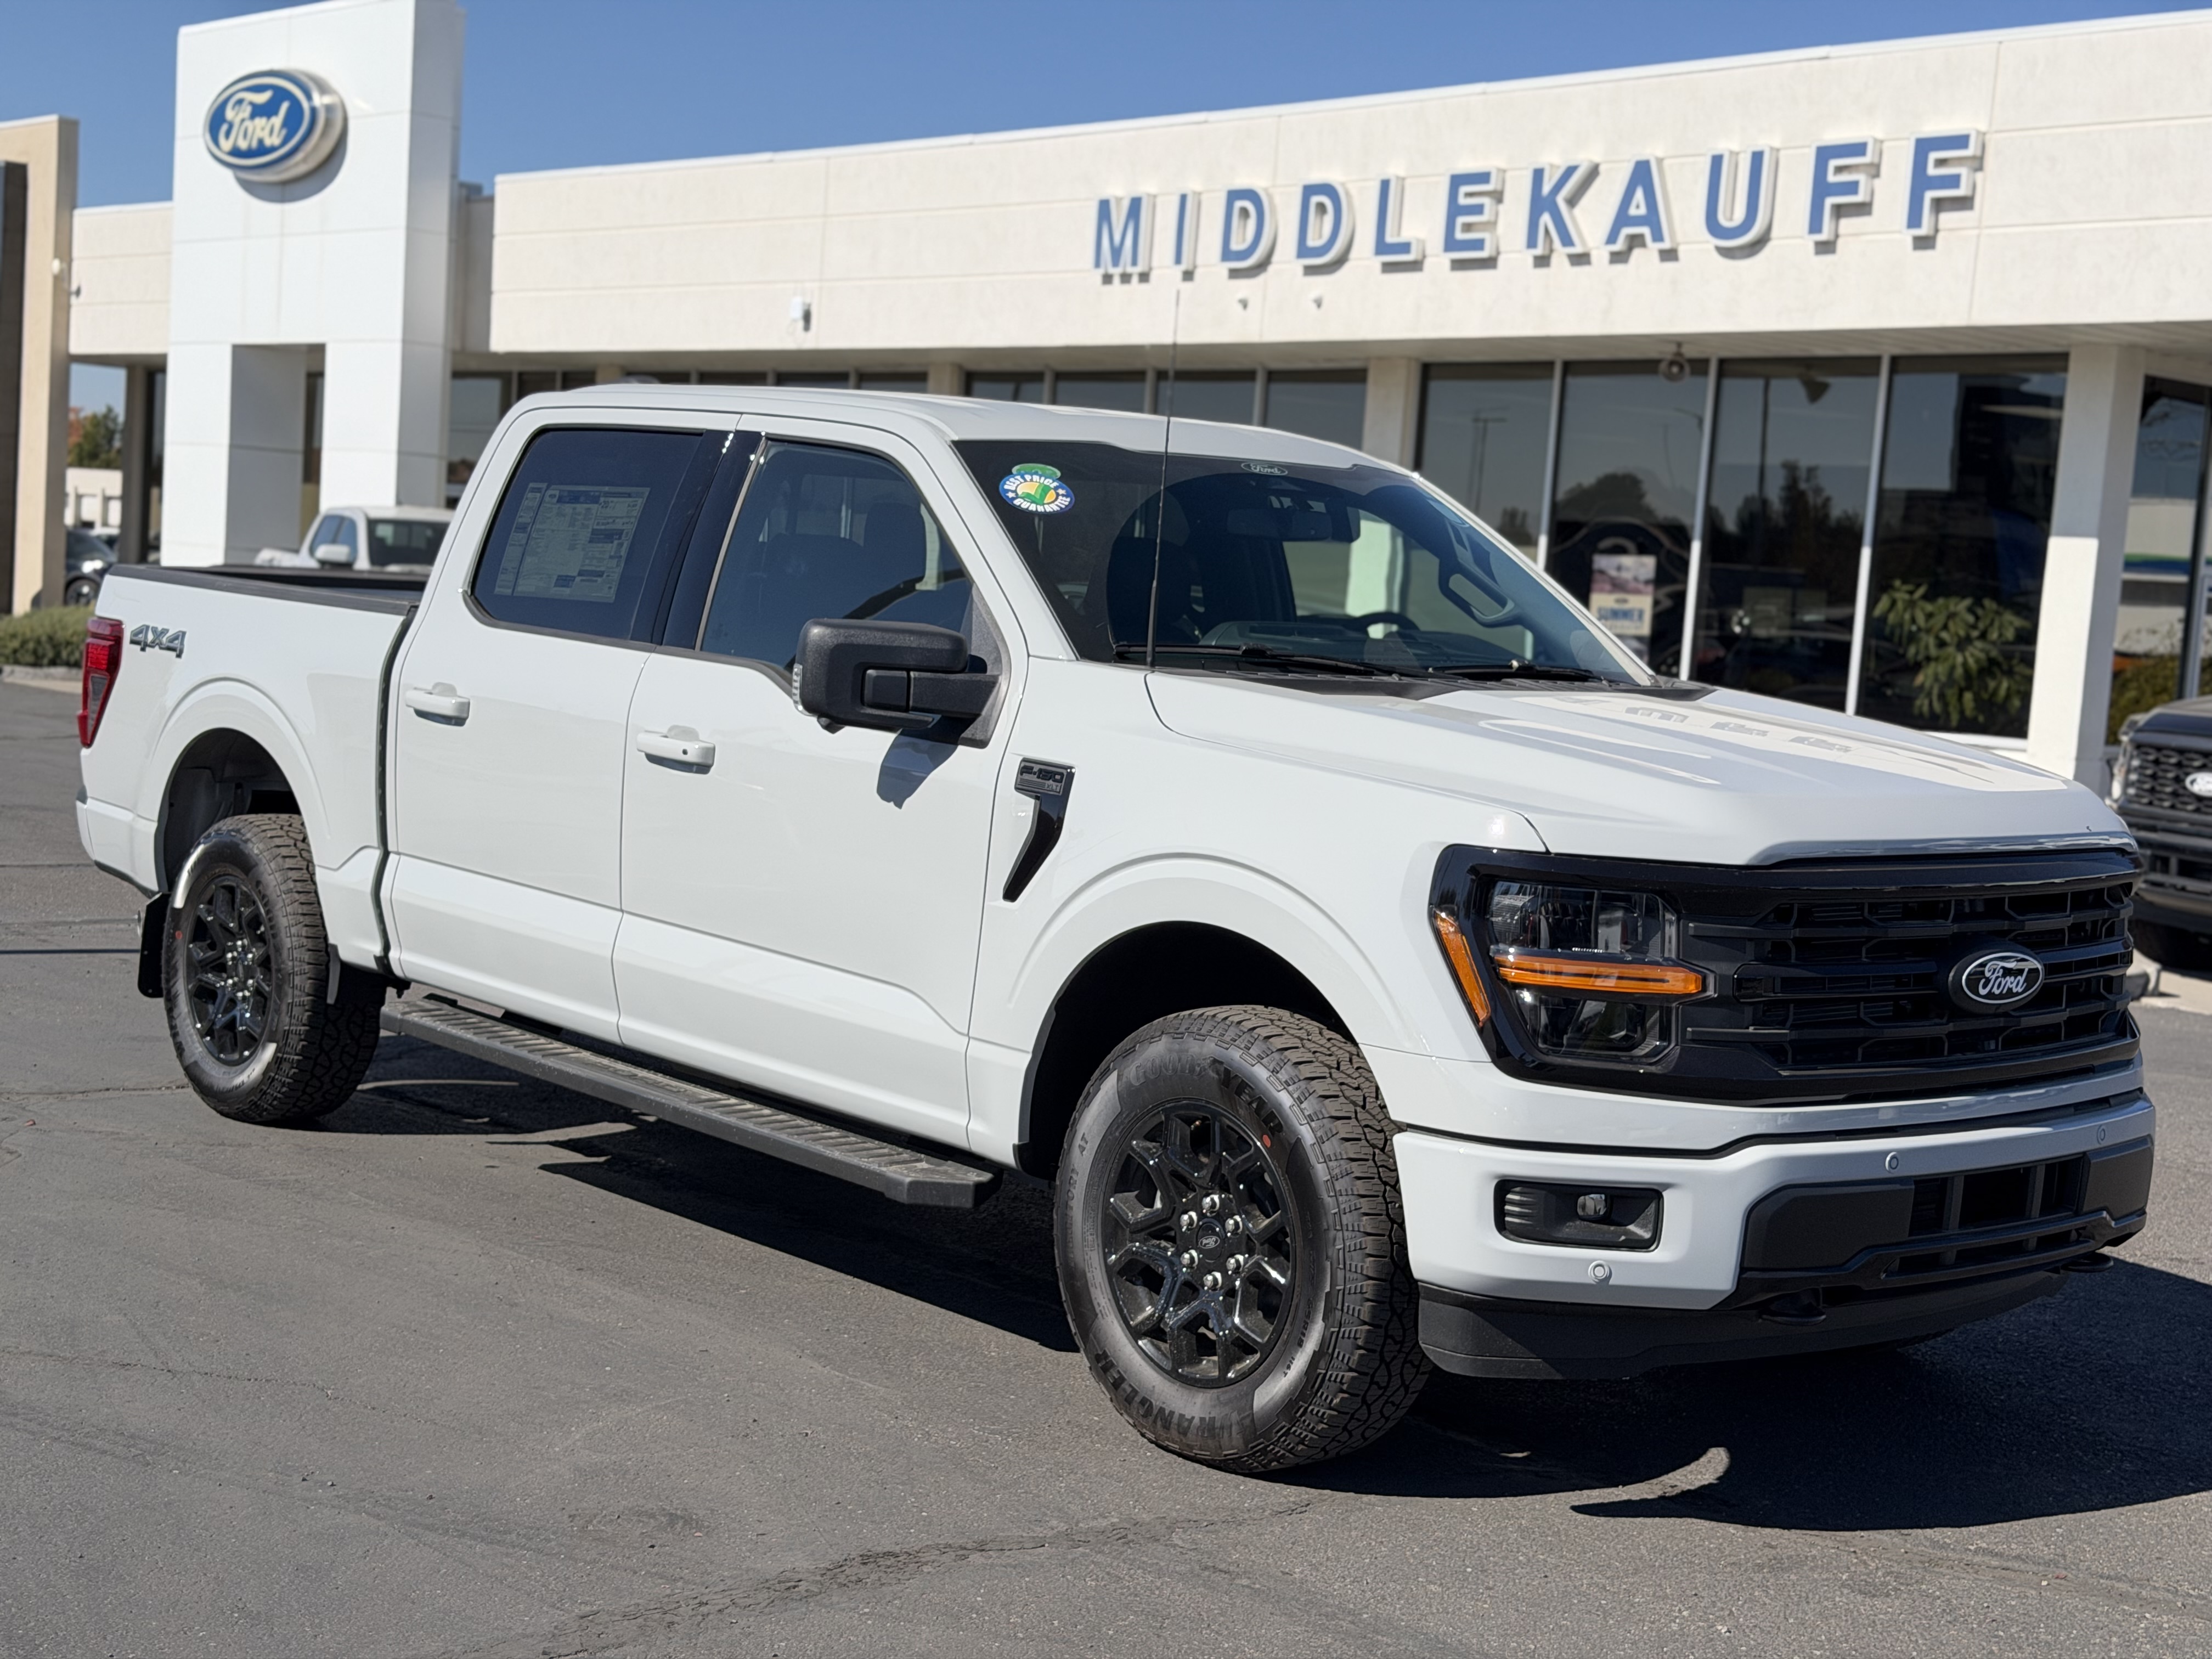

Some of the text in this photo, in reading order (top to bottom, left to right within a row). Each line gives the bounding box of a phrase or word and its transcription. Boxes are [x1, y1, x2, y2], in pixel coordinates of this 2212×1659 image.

[218, 89, 291, 154] Ford
[1094, 131, 1979, 273] MIDDLEKAUFF
[1249, 462, 1281, 474] Ford
[1003, 474, 1059, 491] BEST PRICE
[1013, 495, 1071, 512] GUARANTEE
[1019, 764, 1065, 784] F-150
[1046, 783, 1059, 791] XLT
[1978, 961, 2028, 996] Ford
[1129, 1052, 1284, 1137] GOODYEAR
[1094, 1346, 1252, 1438] WRANGLER
